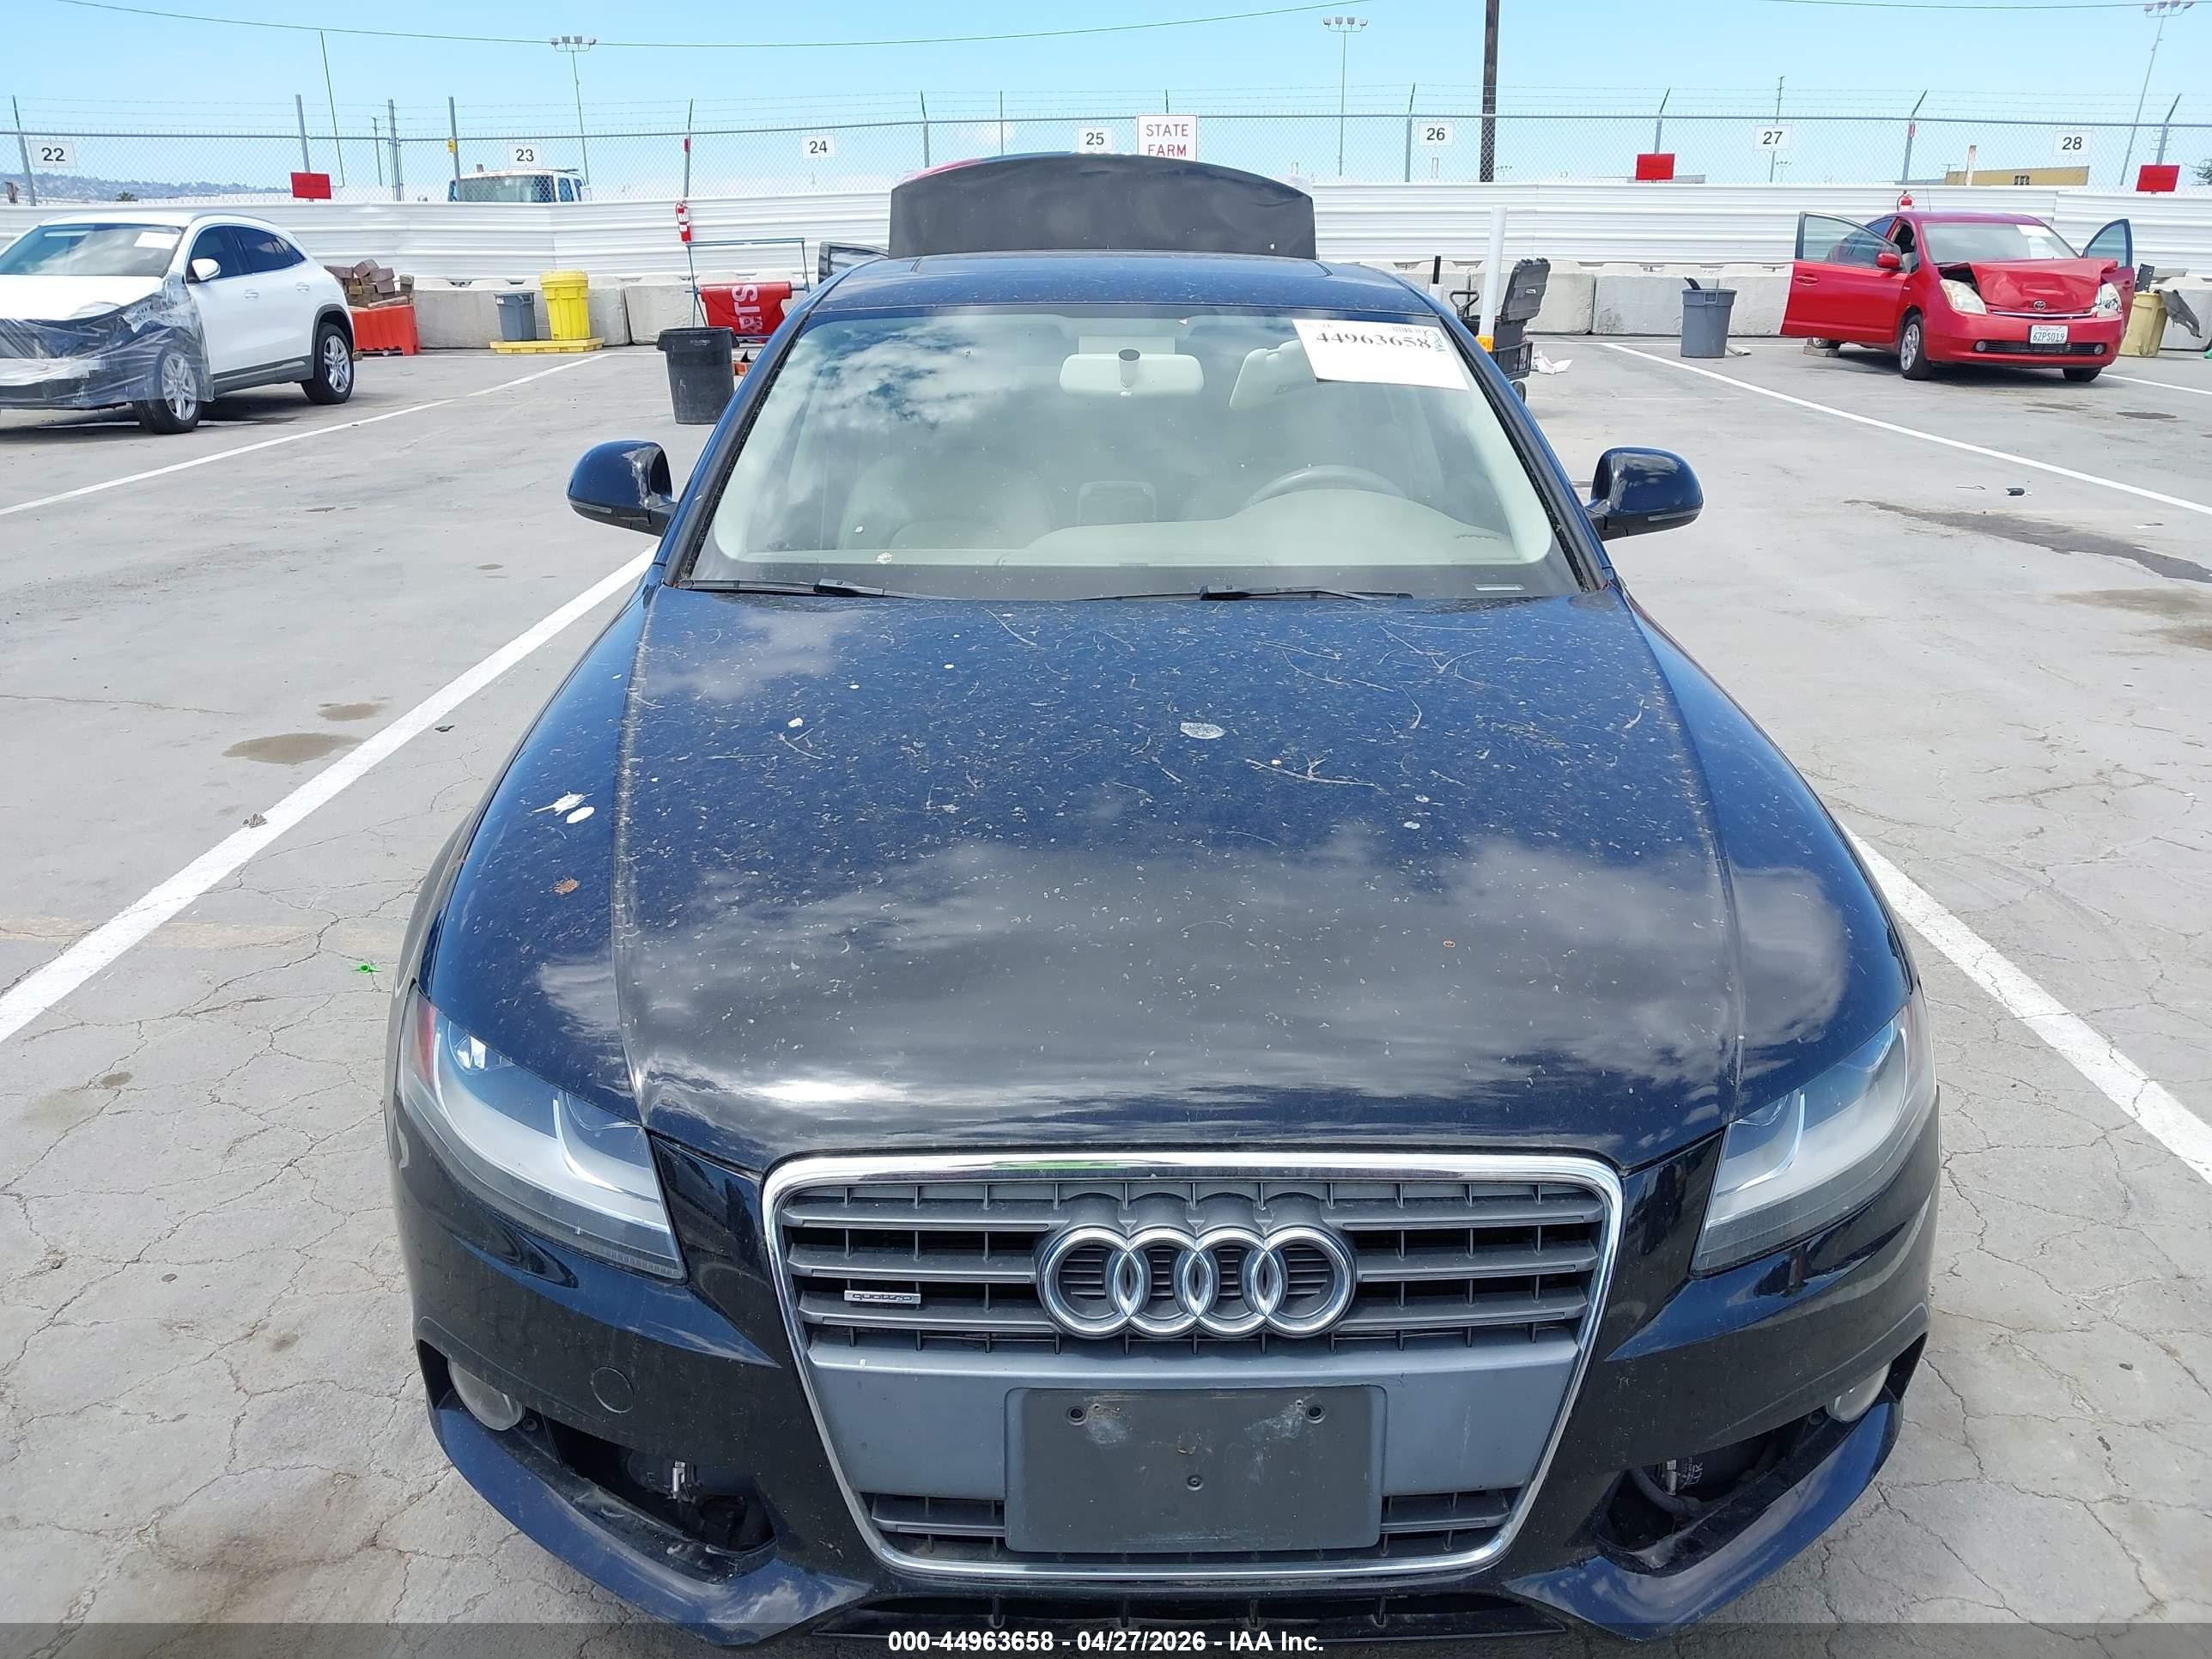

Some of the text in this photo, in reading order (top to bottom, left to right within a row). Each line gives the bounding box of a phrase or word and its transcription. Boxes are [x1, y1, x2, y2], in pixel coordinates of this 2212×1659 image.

[1146, 124, 1189, 137] STATE
[1426, 127, 1445, 141] 26
[1085, 132, 1104, 145] 25
[1762, 131, 1784, 145] 27
[2062, 136, 2082, 150] 28
[809, 140, 828, 154] 24
[1147, 143, 1187, 157] FARM
[41, 147, 66, 162] 22
[515, 149, 534, 162] 23
[1316, 331, 1431, 349] 44963658
[852, 1293, 913, 1302] quattro
